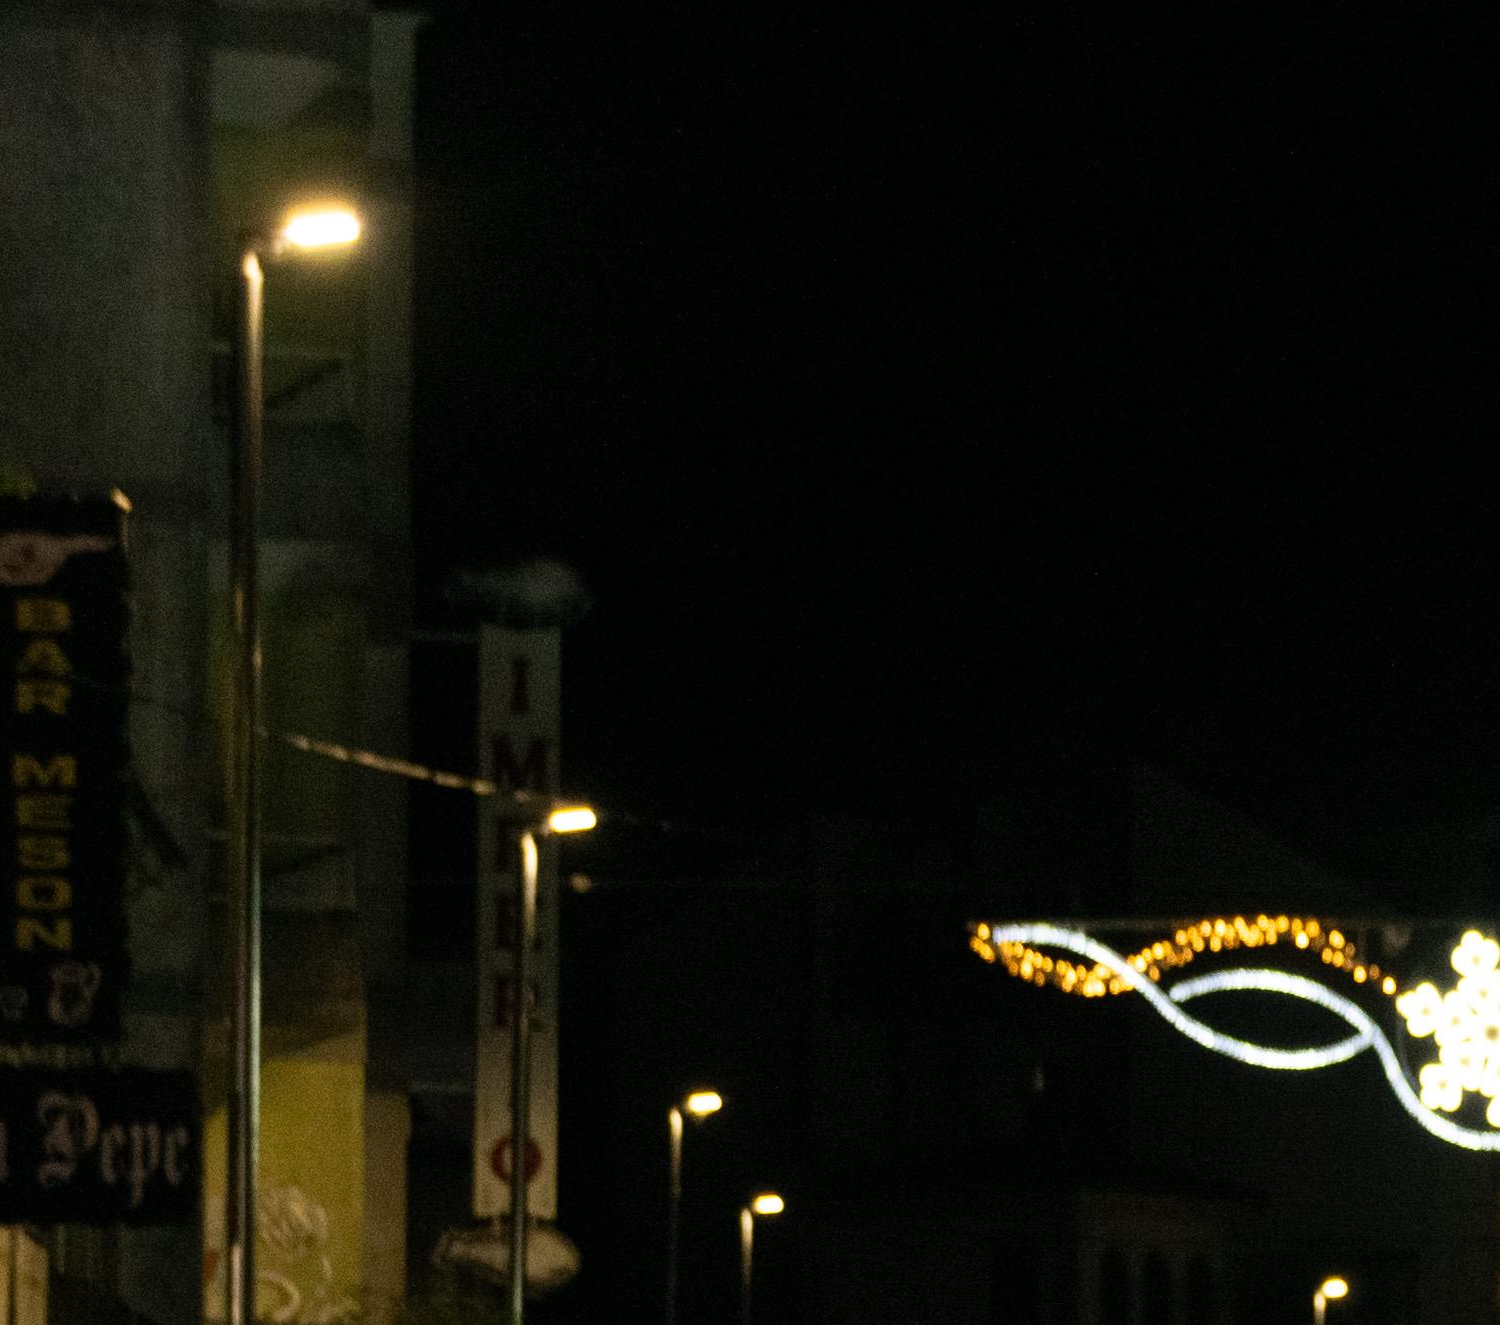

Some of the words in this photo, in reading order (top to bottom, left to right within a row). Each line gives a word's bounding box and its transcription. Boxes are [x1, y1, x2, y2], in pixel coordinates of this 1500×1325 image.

[12, 597, 74, 717] BAR
[10, 753, 79, 951] MESON
[35, 1090, 191, 1210] Pepe
